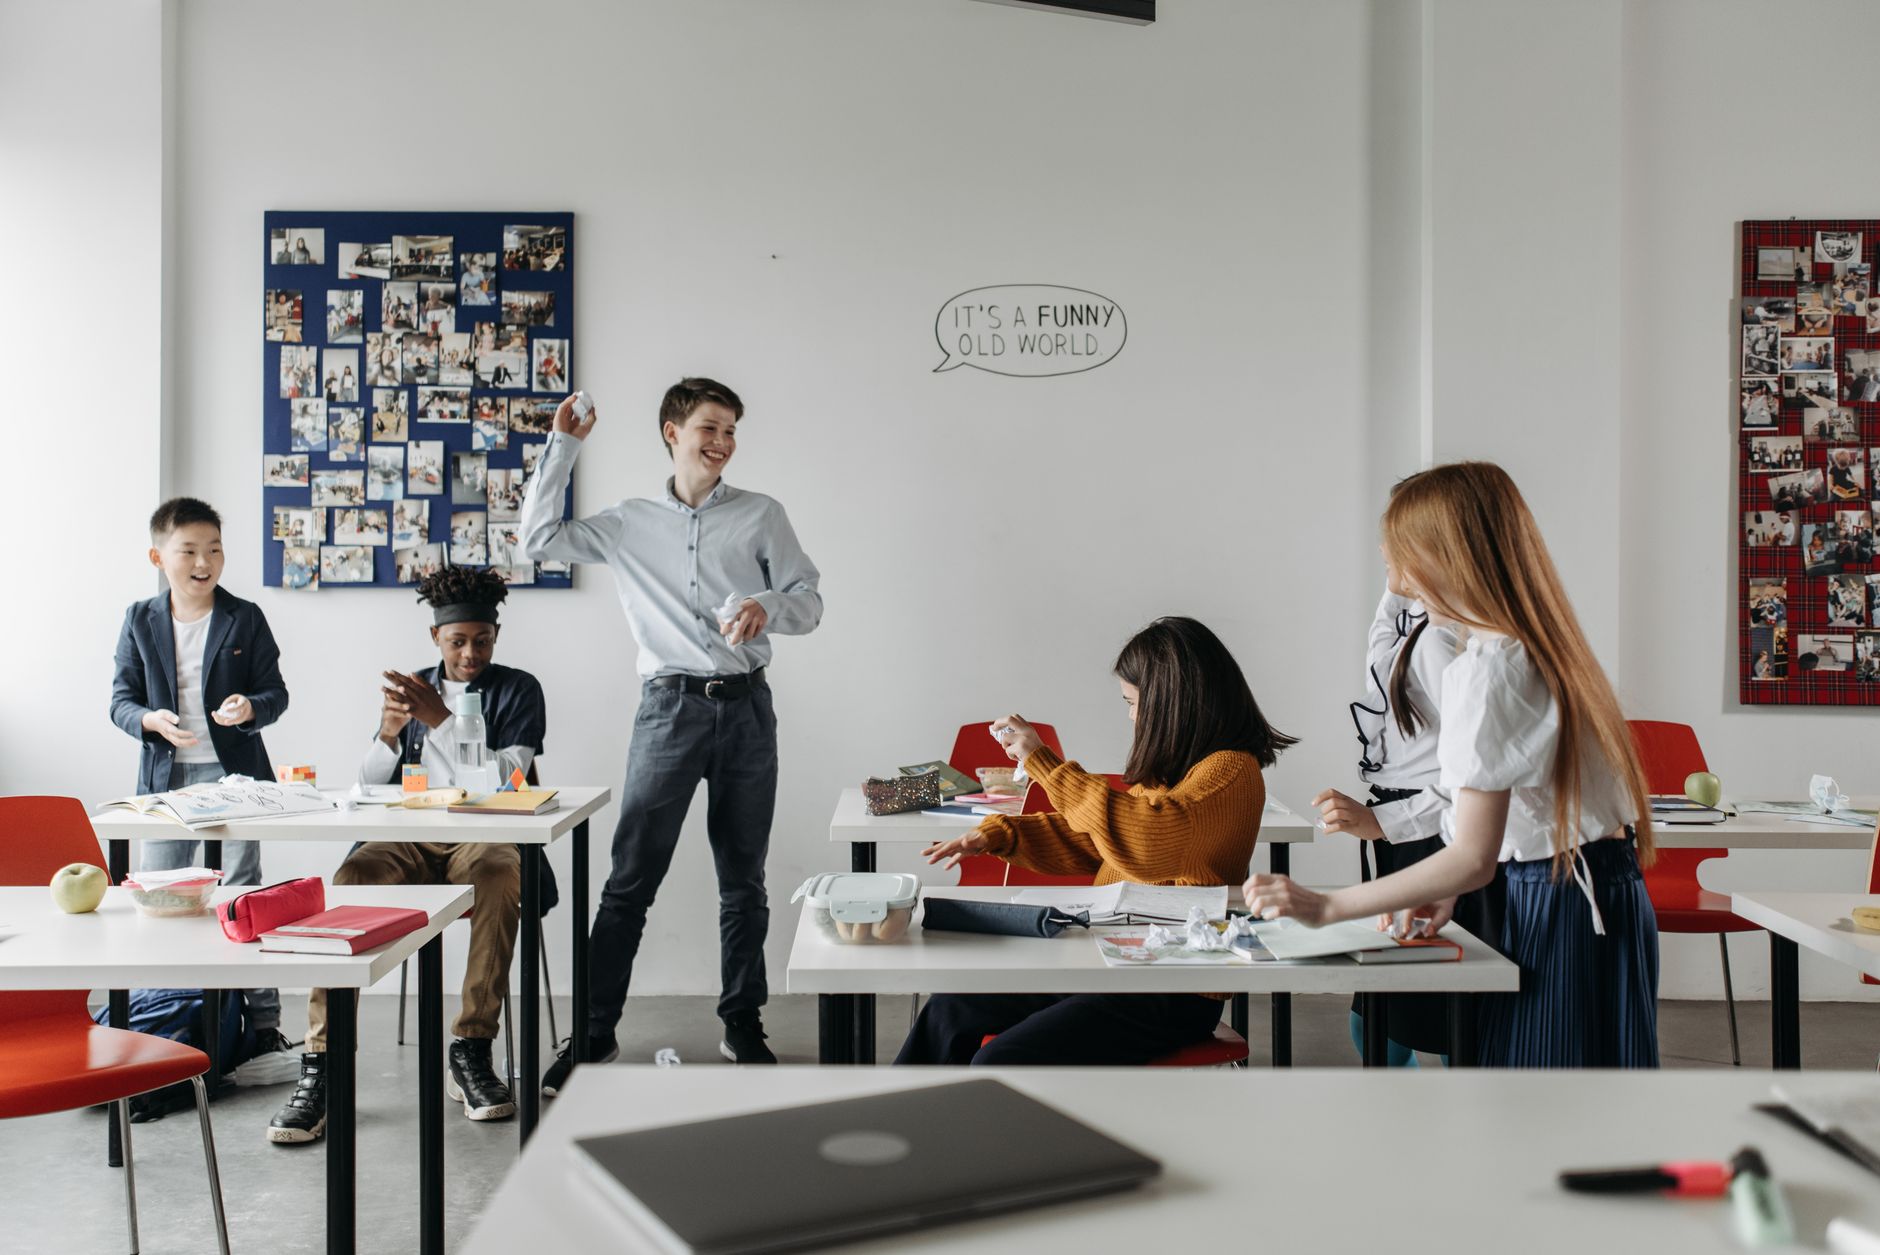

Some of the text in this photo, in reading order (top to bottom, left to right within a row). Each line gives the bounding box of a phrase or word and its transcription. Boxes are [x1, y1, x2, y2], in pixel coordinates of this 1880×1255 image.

[955, 304, 1114, 329] IT'S A FUNNY
[959, 333, 1005, 356] OLD
